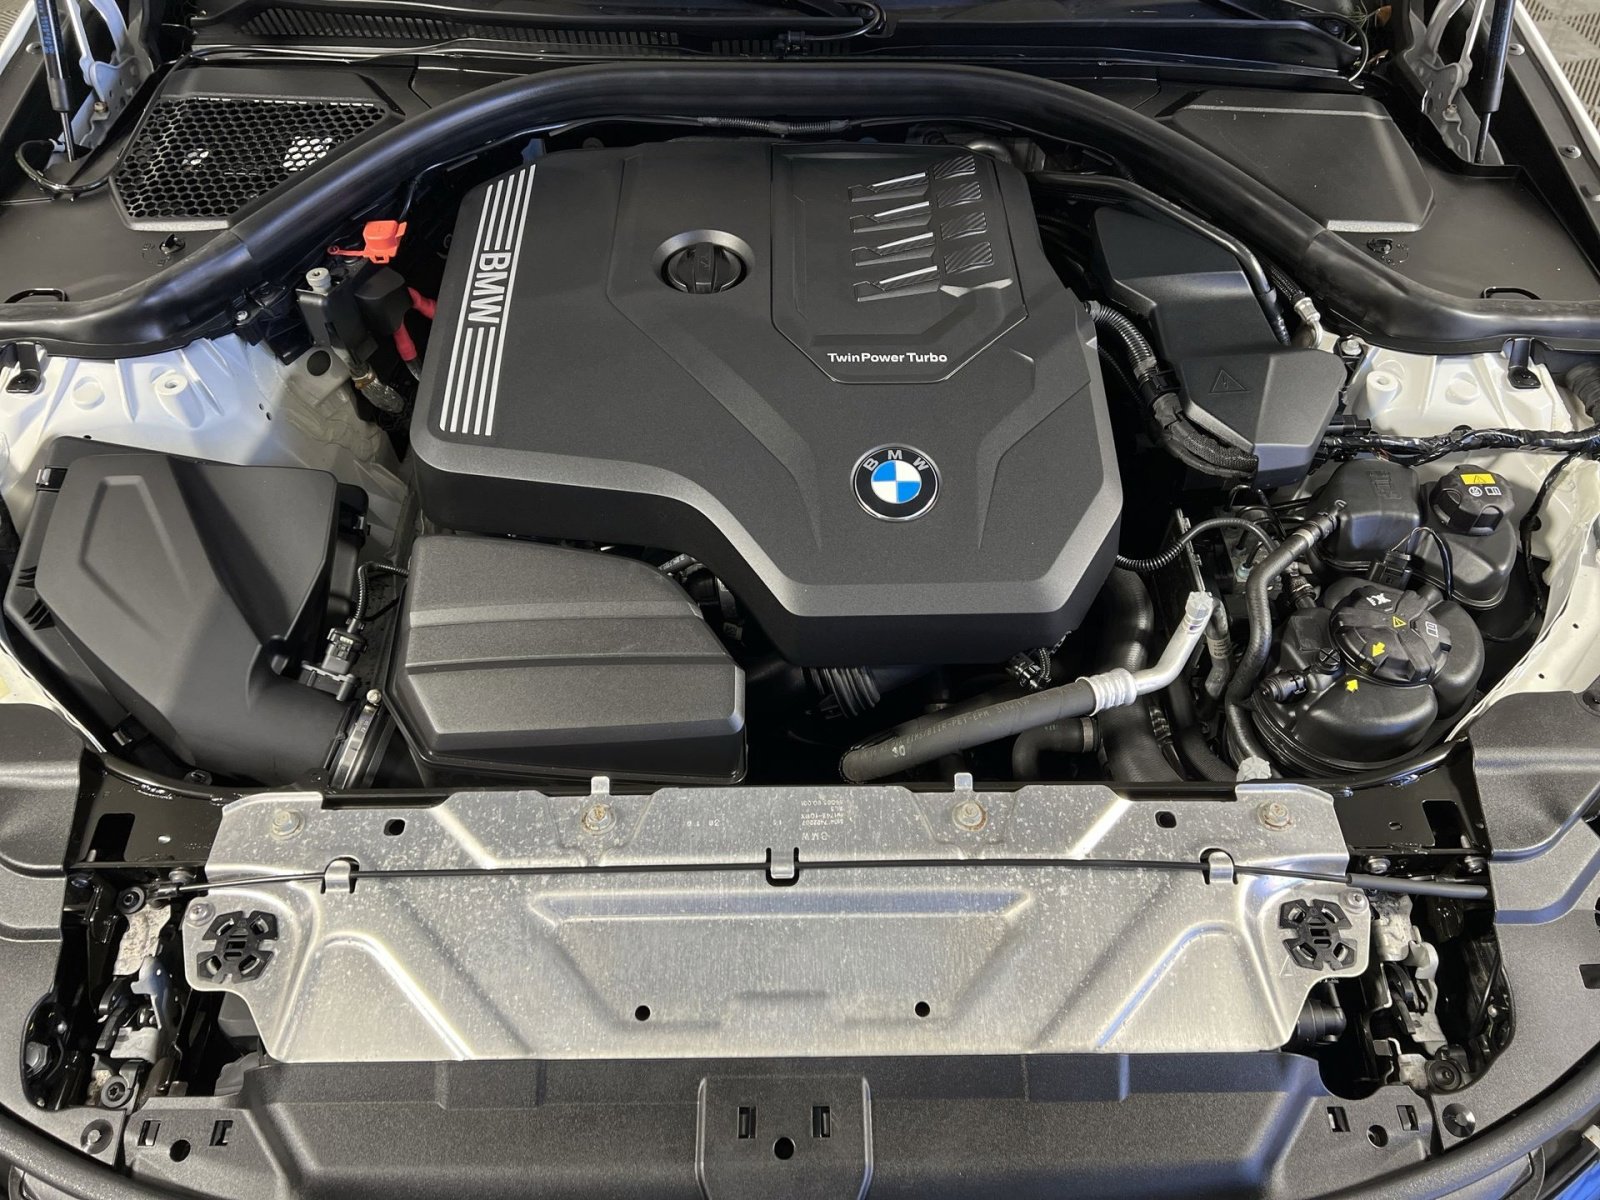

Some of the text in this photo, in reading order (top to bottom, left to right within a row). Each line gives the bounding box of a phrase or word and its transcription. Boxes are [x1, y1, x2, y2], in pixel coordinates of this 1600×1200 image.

[468, 252, 512, 324] BMW
[906, 352, 948, 363] Turbo
[862, 449, 930, 472] BMW
